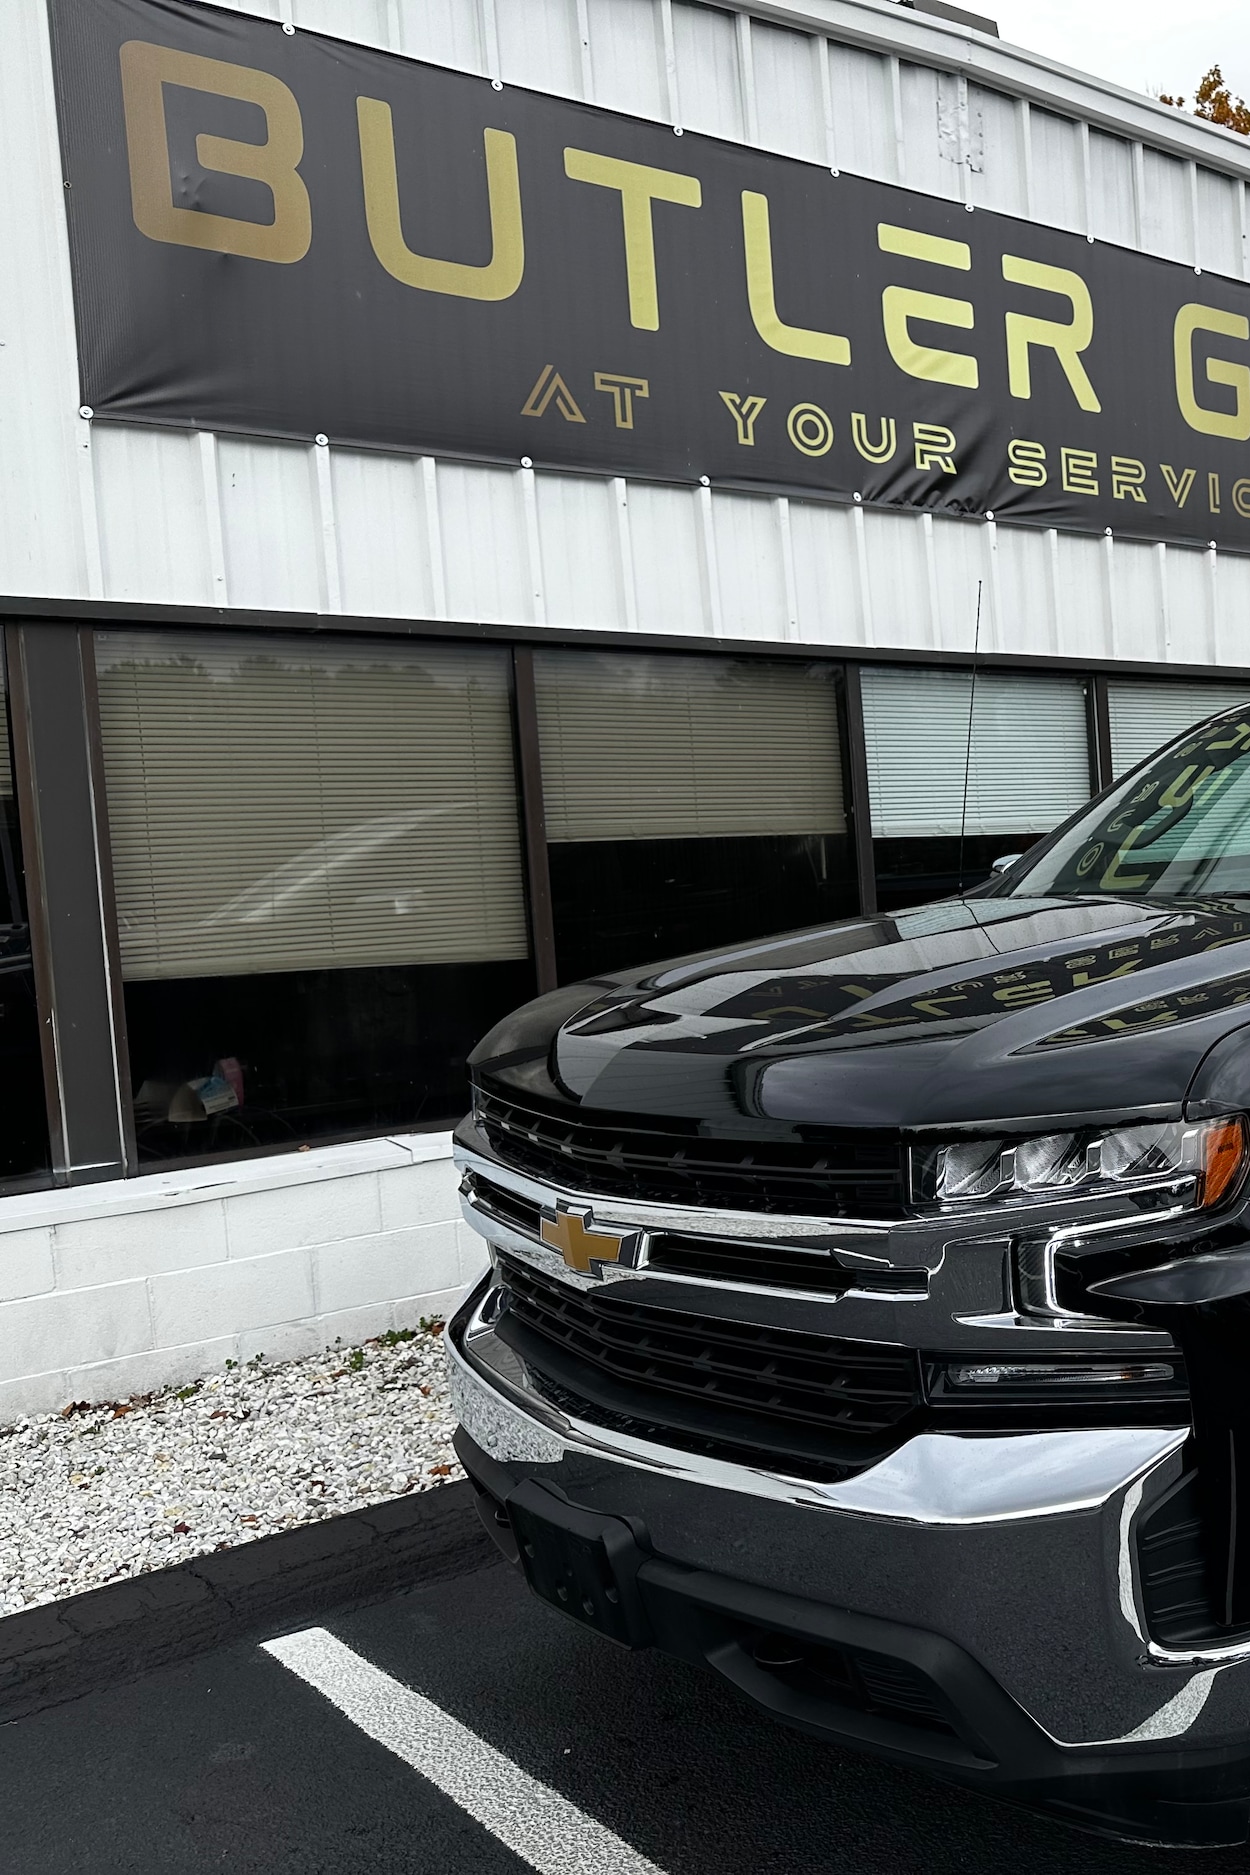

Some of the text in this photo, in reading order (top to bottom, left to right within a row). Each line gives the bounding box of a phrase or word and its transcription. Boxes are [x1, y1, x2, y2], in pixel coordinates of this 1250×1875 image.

[119, 40, 1101, 413] BUTLER
[521, 364, 649, 429] AT
[718, 391, 957, 474] YOUR
